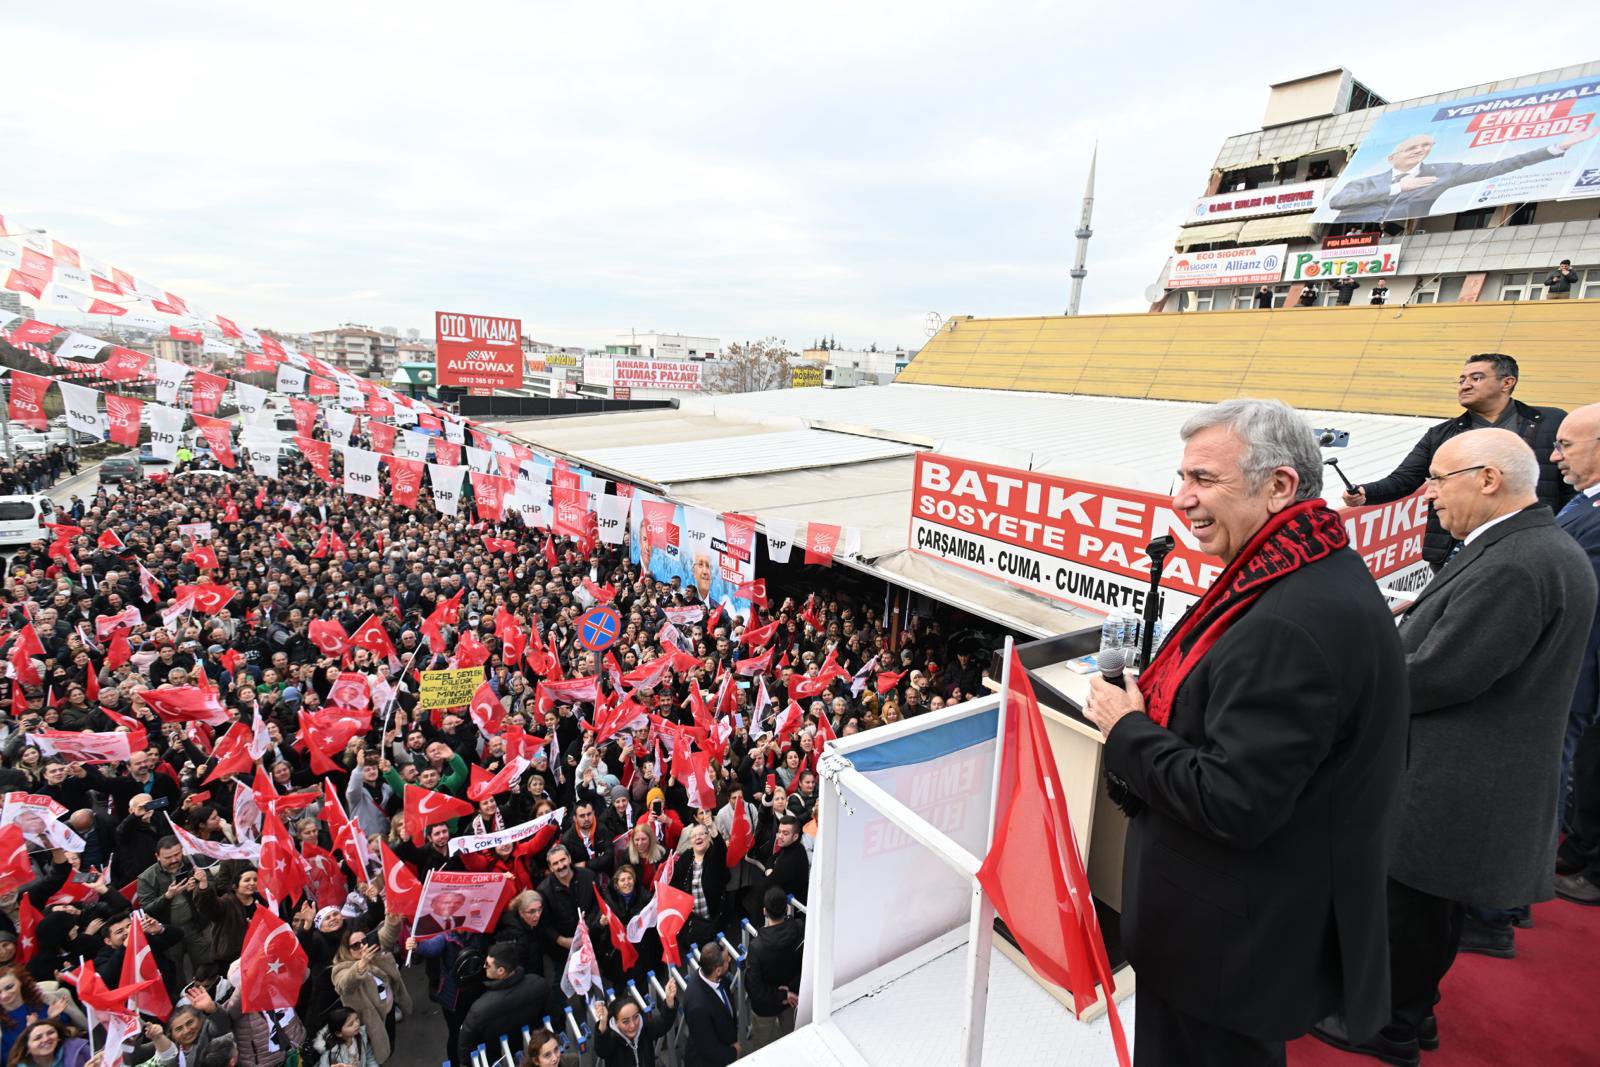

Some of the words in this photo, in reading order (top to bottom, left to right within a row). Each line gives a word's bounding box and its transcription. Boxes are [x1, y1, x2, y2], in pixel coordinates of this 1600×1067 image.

[1447, 84, 1600, 118] YENİMAHAL
[1479, 103, 1556, 129] EMİN
[1476, 115, 1588, 145] ELLERDE
[1225, 260, 1261, 271] Allianz
[440, 314, 466, 337] OTO
[469, 317, 518, 341] YIKAMA
[448, 360, 514, 373] AUTOWAX
[616, 361, 649, 369] ANKARA
[652, 362, 678, 371] BURSA
[617, 369, 657, 382] KUMAŞ
[660, 371, 698, 382] PAZARI
[252, 451, 271, 462] CHP
[350, 472, 372, 483] CHP
[395, 484, 413, 493] CHP
[435, 489, 453, 500] CHP
[477, 496, 496, 506] CHP
[920, 461, 1202, 551] BATIKEN
[522, 504, 541, 513] CHP
[558, 513, 577, 522] CHP
[599, 518, 618, 528] CHP
[1345, 495, 1429, 551] ATIKE
[647, 525, 664, 534] CHP
[769, 538, 787, 548] CHP
[919, 495, 1065, 551] SOSYETE
[1078, 534, 1223, 590] PAZAR
[667, 544, 678, 557] CHP
[813, 544, 831, 553] CHP
[721, 554, 737, 570] EMİN
[917, 526, 986, 566] ÇARŞAMBA
[999, 550, 1040, 583] CUMA
[1055, 568, 1165, 620] CUMARTEİ
[423, 672, 453, 682] GÜZEL
[475, 840, 493, 851] ÇOK
[471, 875, 489, 883] ÇOK
